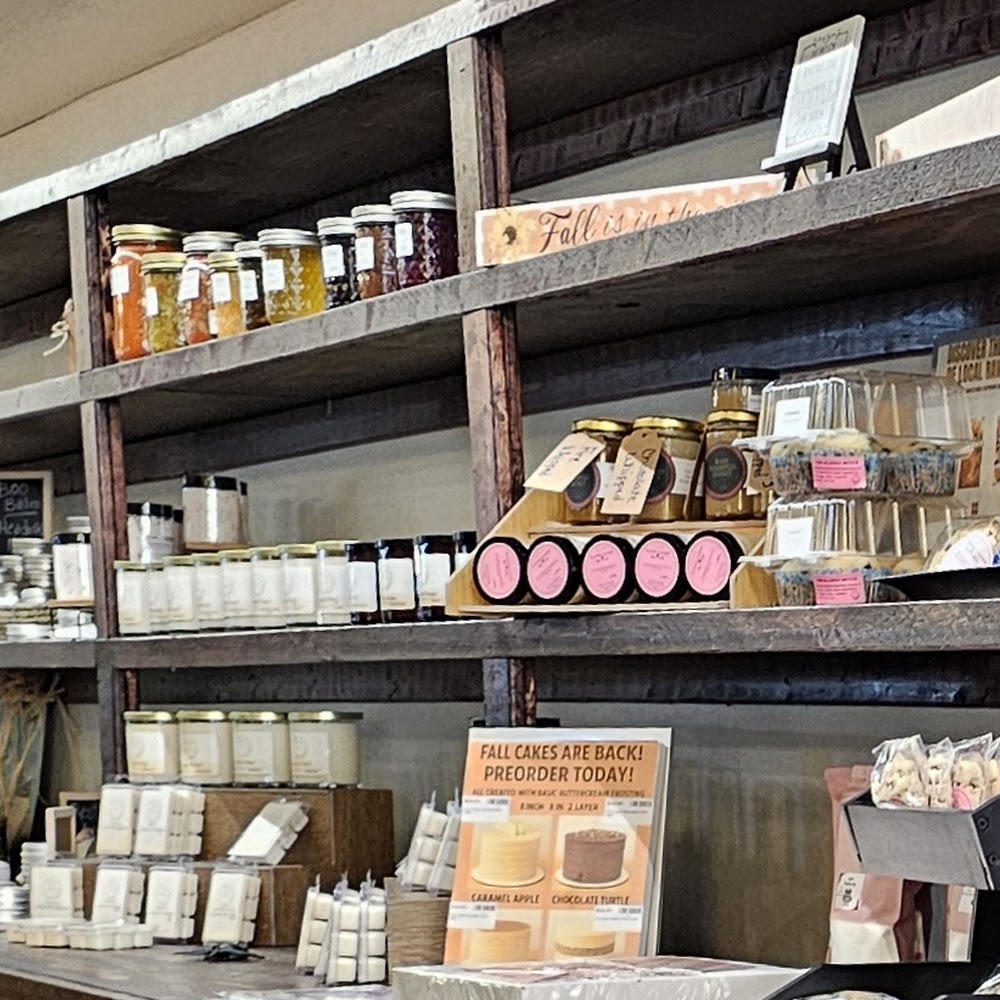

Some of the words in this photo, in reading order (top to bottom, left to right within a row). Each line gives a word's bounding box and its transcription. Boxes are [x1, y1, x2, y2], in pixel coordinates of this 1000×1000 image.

[538, 204, 599, 253] Fall
[603, 213, 624, 235] is
[948, 340, 986, 363] DISCOVER
[959, 362, 982, 384] LOCAL
[480, 744, 511, 761] FALL
[514, 744, 558, 761] CAKES
[561, 744, 590, 761] ARE
[595, 745, 643, 761] BACK!
[484, 766, 569, 783] PREORDER
[574, 766, 634, 783] TODAY!
[518, 789, 536, 797] WITH
[537, 789, 558, 797] BASIC
[559, 789, 609, 797] BUTTERCREAM
[610, 789, 645, 798] FROSTING
[526, 803, 545, 811] INCH
[568, 803, 573, 811] 2
[575, 803, 599, 811] LAYER
[471, 894, 511, 904] CARAMEL
[513, 895, 540, 904] APPLE
[552, 895, 600, 906] CHOCOLATE
[601, 896, 629, 906] TURTLE
